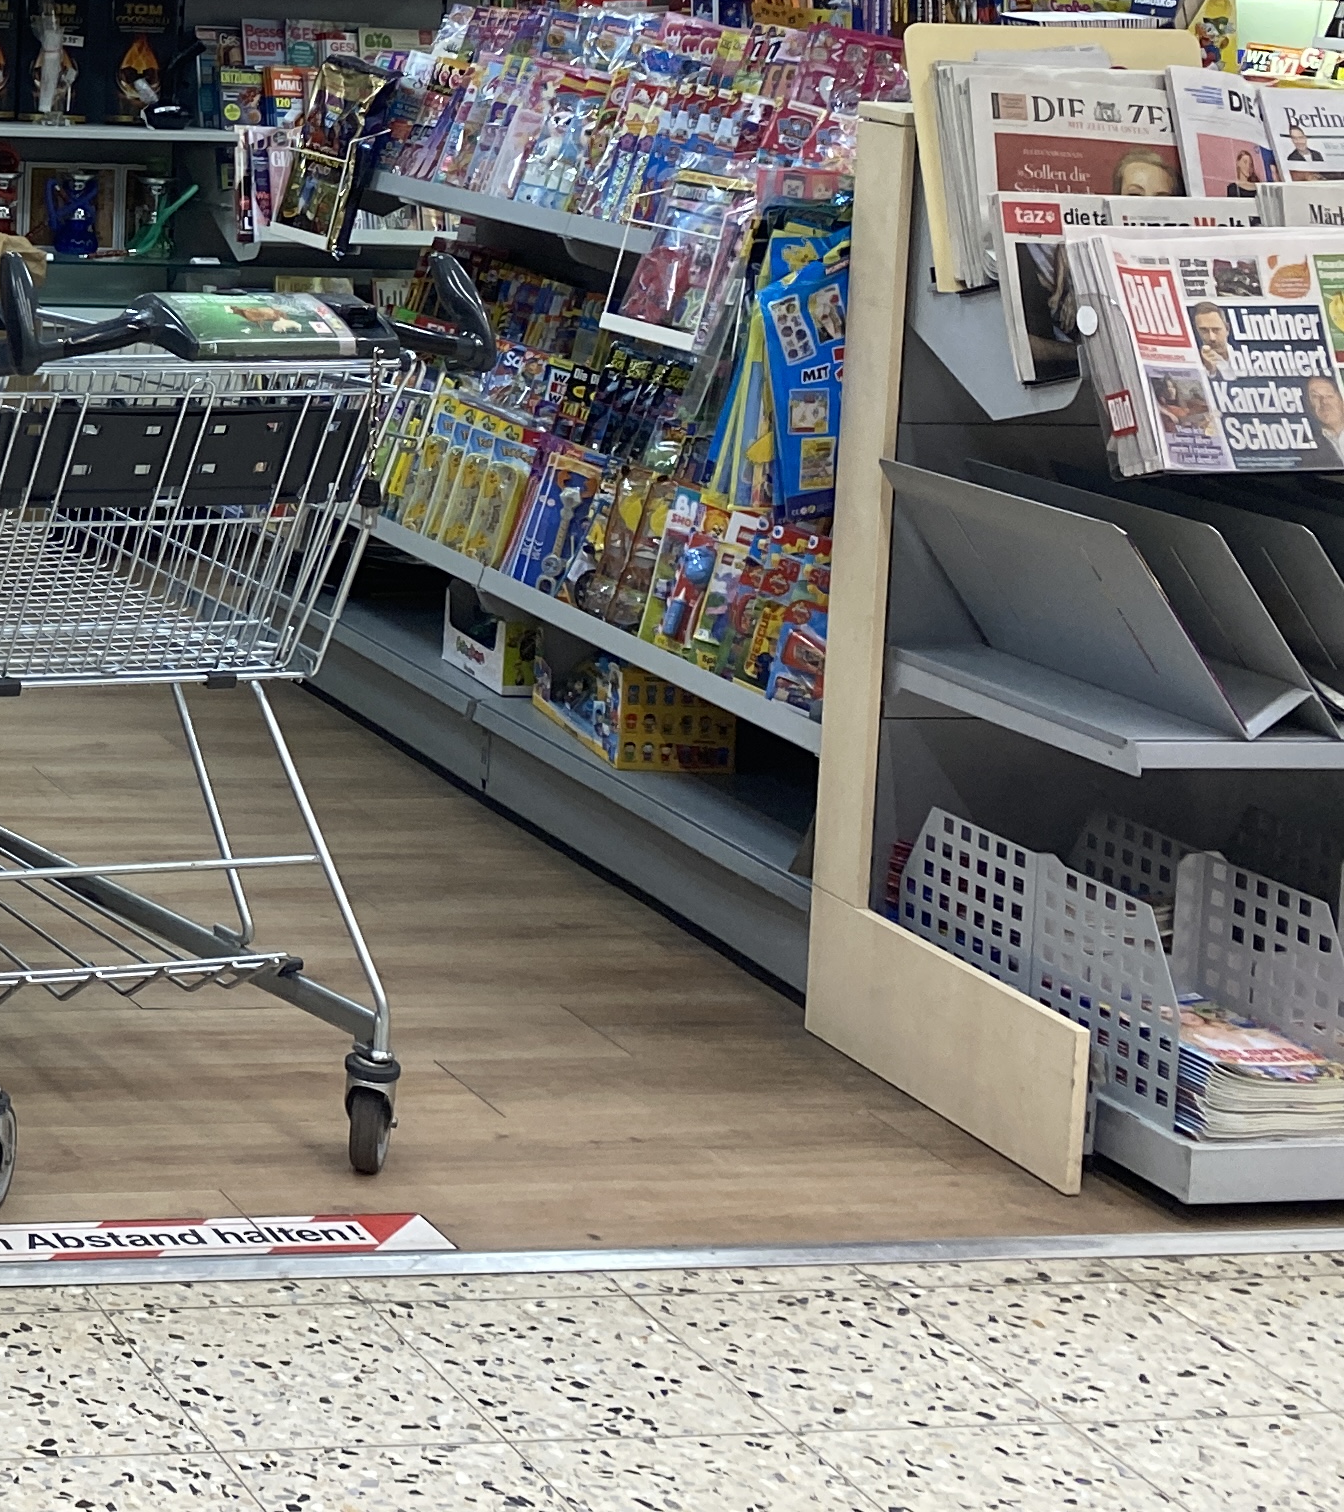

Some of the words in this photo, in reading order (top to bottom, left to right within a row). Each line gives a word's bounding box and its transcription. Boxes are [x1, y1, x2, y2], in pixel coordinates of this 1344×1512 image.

[1030, 95, 1085, 122] DIE
[1013, 206, 1045, 224] taz
[1119, 270, 1183, 338] Bild
[1226, 306, 1320, 341] Lindner
[1228, 343, 1332, 379] blamiert
[1214, 380, 1303, 415] Kanzler
[1221, 416, 1318, 451] Scholz!
[28, 1224, 212, 1253] Abstand
[220, 1220, 368, 1249] halten!
